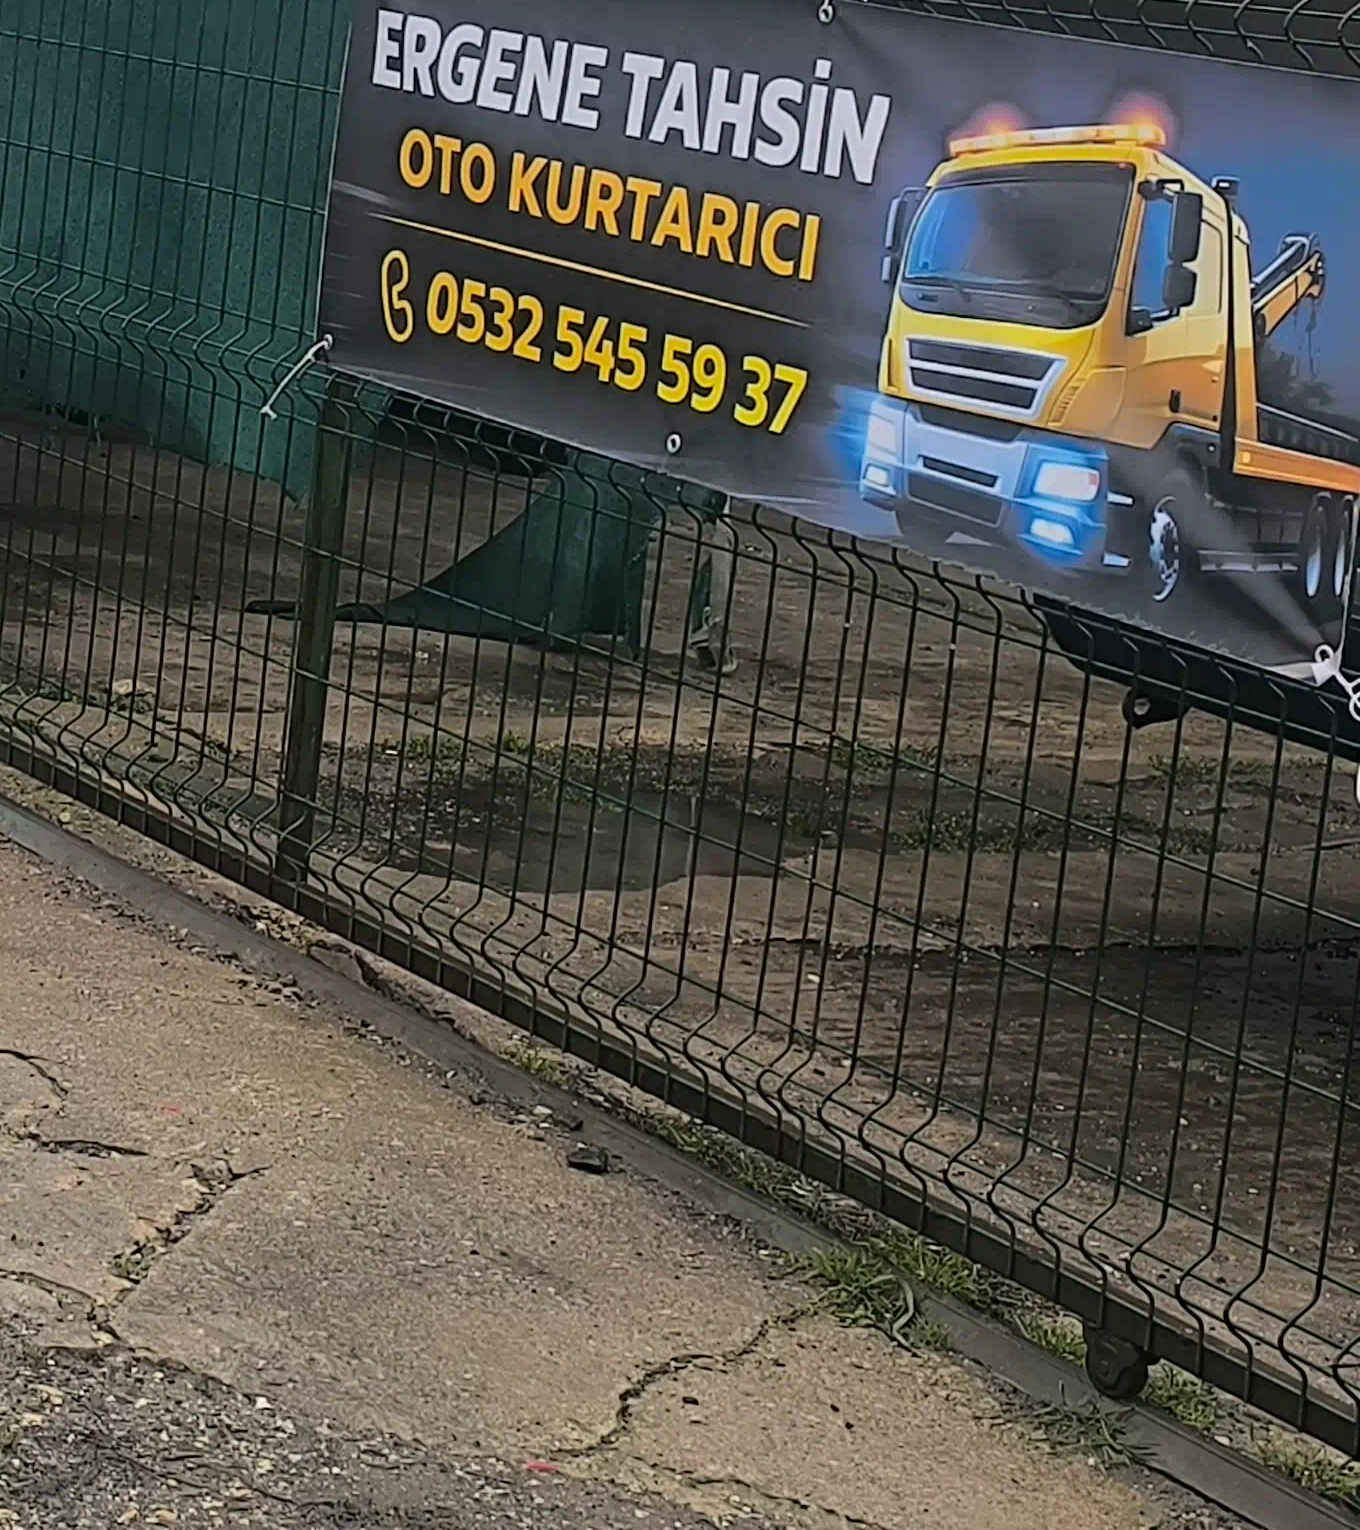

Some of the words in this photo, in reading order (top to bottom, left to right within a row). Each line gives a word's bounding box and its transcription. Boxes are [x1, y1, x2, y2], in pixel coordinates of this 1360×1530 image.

[371, 8, 609, 130] ERGENE
[621, 51, 892, 186] TAHSİN
[399, 128, 497, 204] OTO
[508, 152, 822, 282] KURTARICI
[426, 271, 544, 363] 0532
[553, 305, 650, 394] 545
[657, 333, 728, 414] 59
[734, 357, 809, 435] 37
